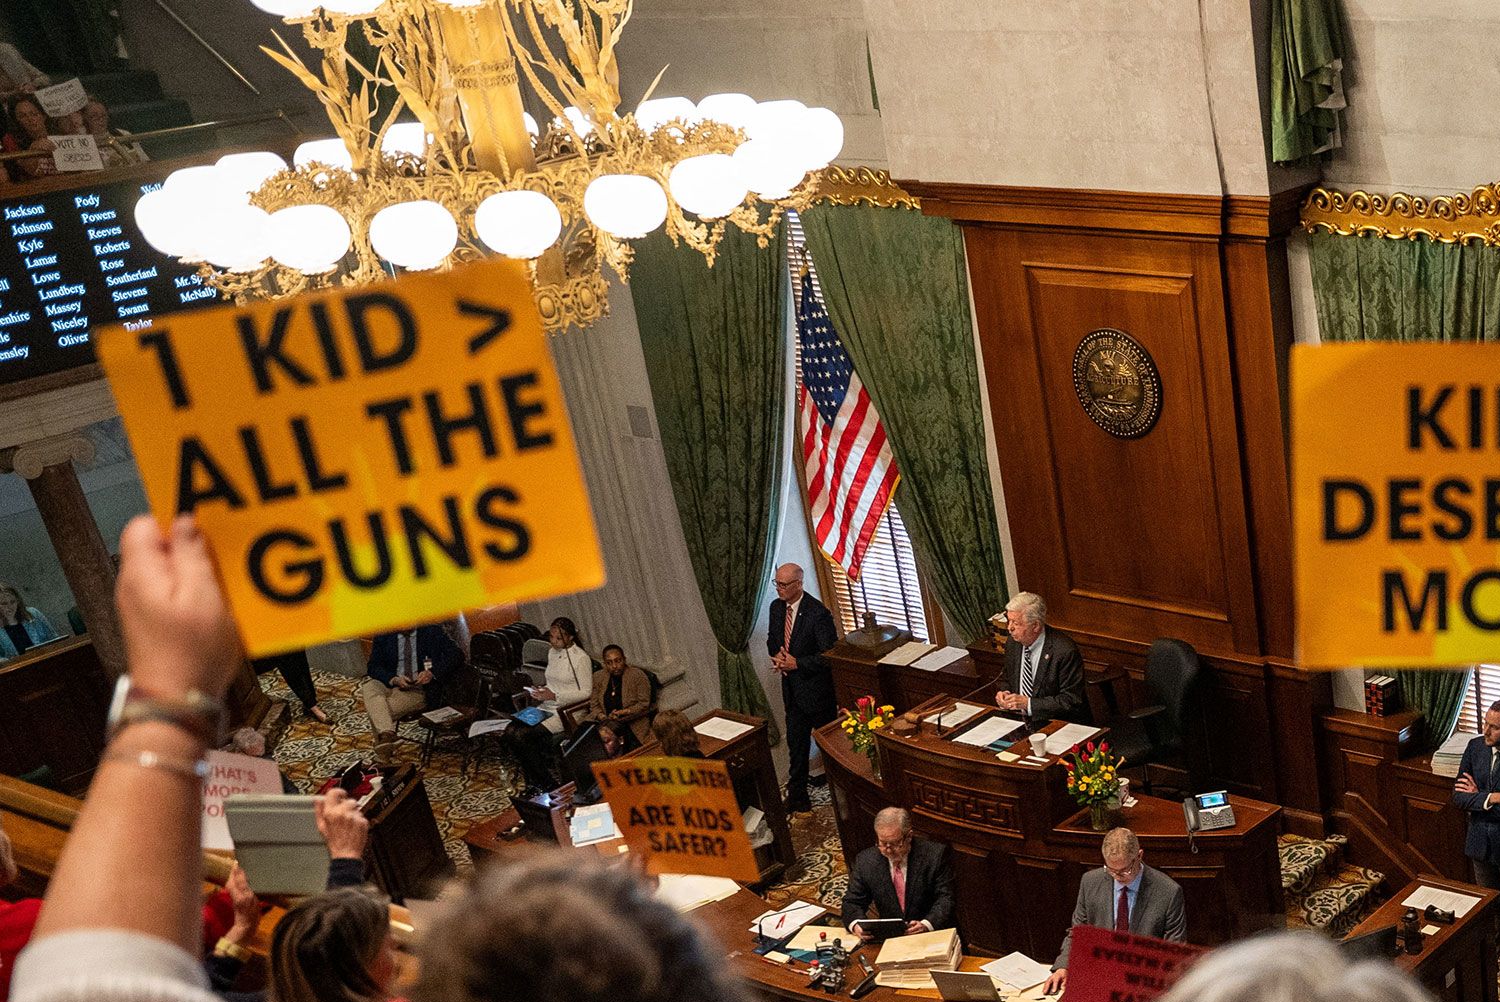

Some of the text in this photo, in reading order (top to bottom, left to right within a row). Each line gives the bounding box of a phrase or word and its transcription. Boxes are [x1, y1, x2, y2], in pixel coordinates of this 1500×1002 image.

[75, 194, 100, 209] Pody
[4, 204, 45, 220] Jackson
[81, 209, 117, 225] Powers
[12, 220, 53, 237] Johnson
[88, 225, 122, 240] Reeves
[18, 239, 45, 254] Kyle
[94, 240, 131, 256] Roberts
[25, 254, 58, 270] Lamar
[100, 258, 125, 273] Rose
[32, 271, 61, 286] Lowe
[106, 266, 158, 288] Southerland
[174, 276, 191, 289] Mr.
[38, 283, 87, 301] Lundberg
[112, 287, 148, 302] Stevens
[180, 286, 217, 303] McNally
[45, 300, 82, 317] Massey
[118, 303, 149, 317] Swann
[51, 316, 88, 333] Niceley
[123, 318, 153, 333] Taylor
[58, 333, 89, 348] Oliver
[1097, 337, 1114, 346] THE
[138, 329, 191, 409] 1
[236, 292, 419, 394] KID
[175, 372, 555, 515] ALL THE
[247, 486, 531, 605] GUNS
[210, 764, 257, 785] HAT'S
[600, 767, 731, 789] 1 YEAR LATER
[629, 805, 734, 832] ARE KIDS
[648, 830, 728, 858] SAFER?
